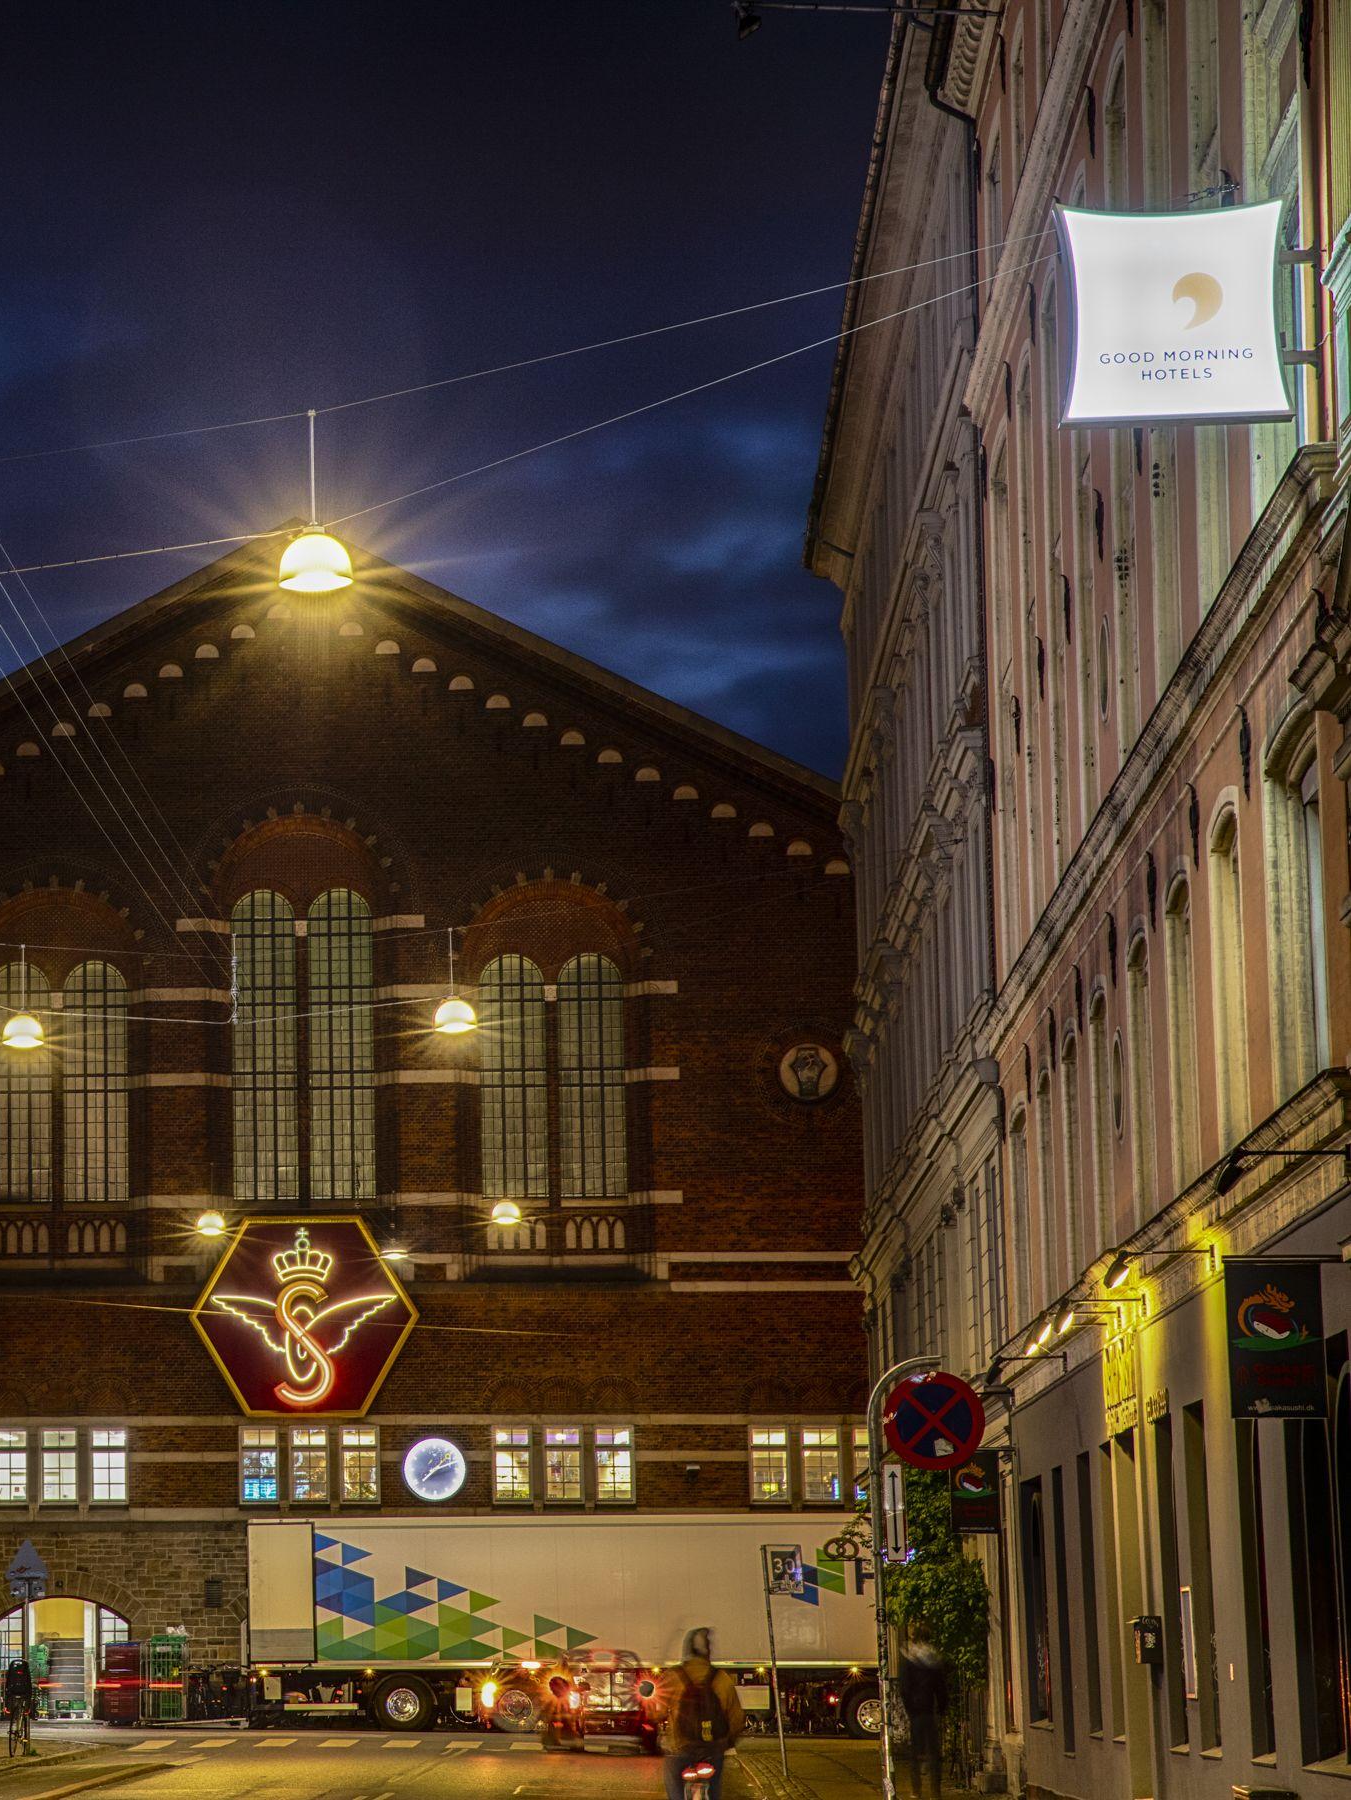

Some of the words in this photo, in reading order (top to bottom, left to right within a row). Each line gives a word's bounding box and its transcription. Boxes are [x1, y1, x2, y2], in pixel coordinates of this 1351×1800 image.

[1100, 352, 1154, 364] GOOD
[1164, 348, 1254, 362] MORNING
[1141, 368, 1213, 381] HOTELS
[773, 1558, 796, 1574] 30
